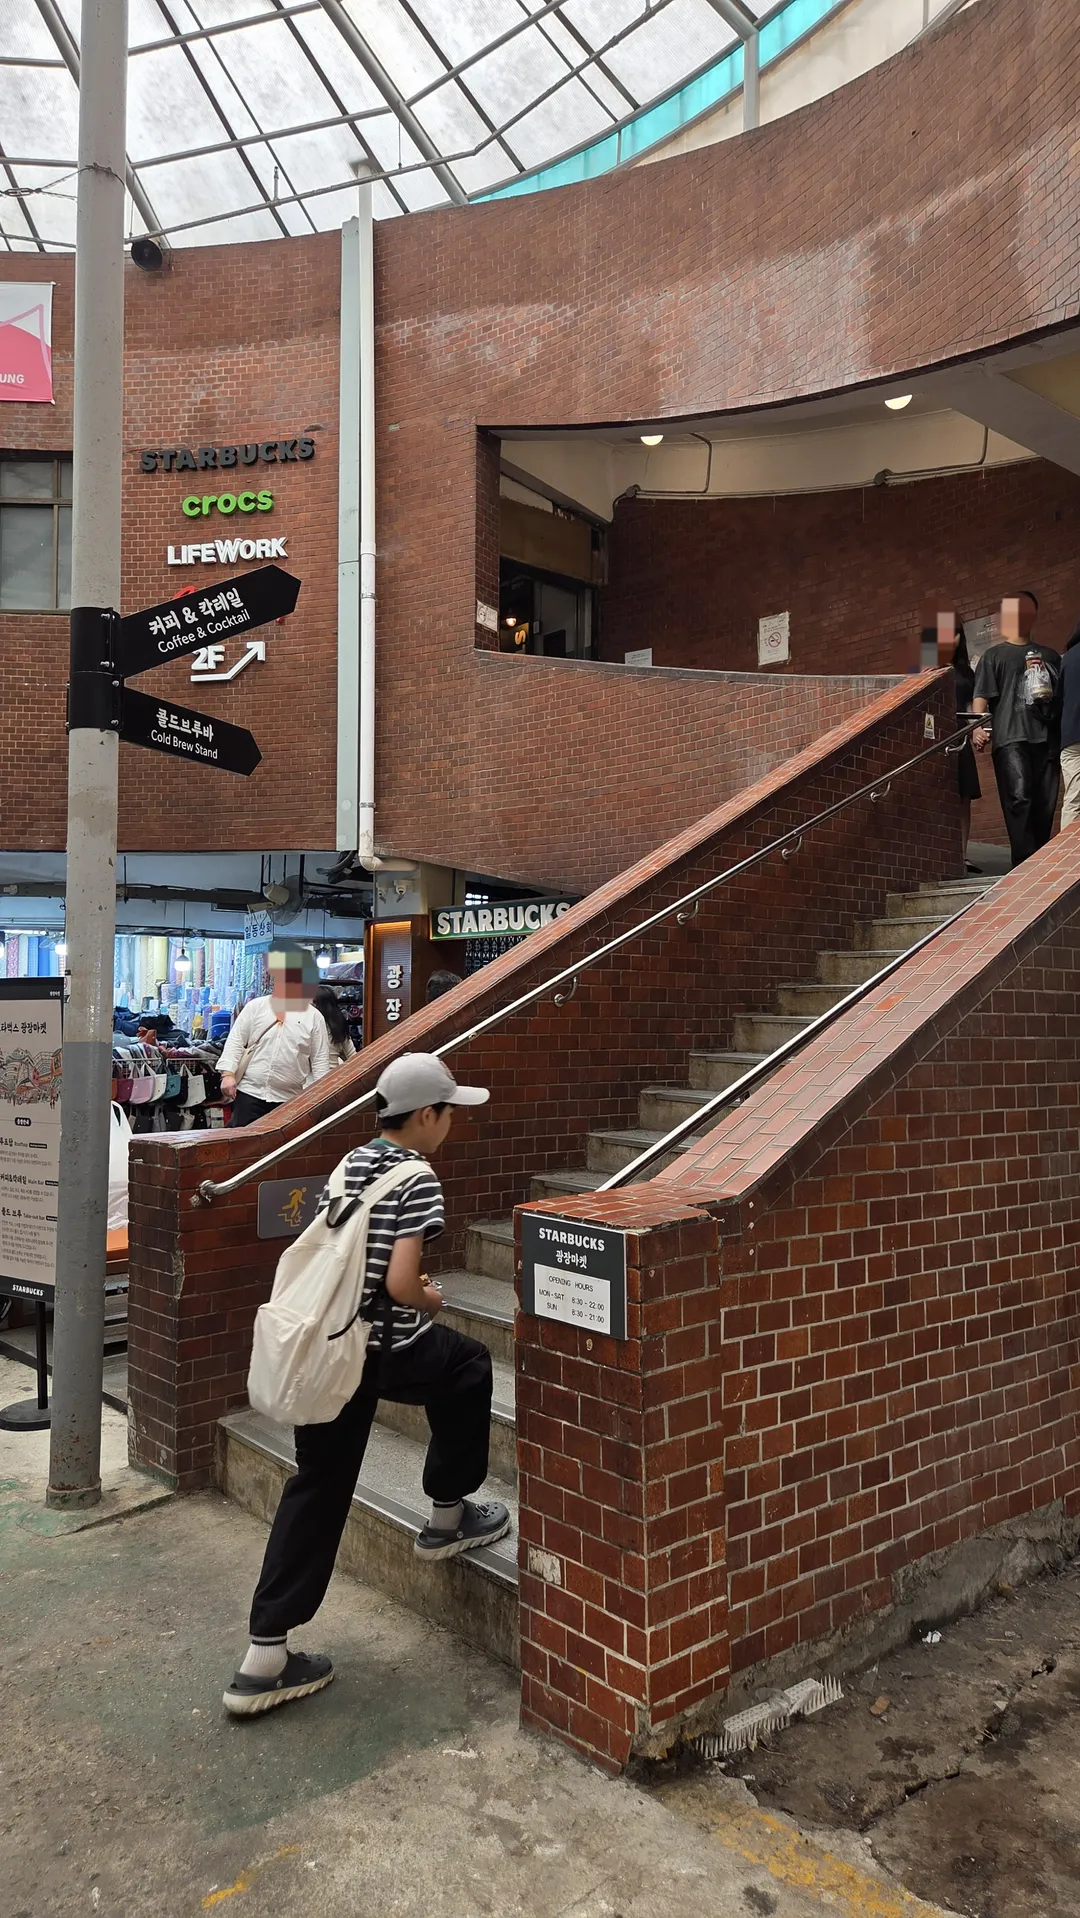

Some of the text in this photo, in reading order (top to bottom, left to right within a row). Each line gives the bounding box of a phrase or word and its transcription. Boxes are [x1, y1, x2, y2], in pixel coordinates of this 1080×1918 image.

[140, 437, 316, 472] STARBUCKS
[182, 490, 274, 517] crocs
[167, 537, 289, 566] LIFEWORK
[148, 587, 244, 635] 커피 & 칵테일
[157, 608, 250, 653] Coffee & Cocktail
[191, 645, 226, 670] 2F
[156, 708, 214, 742] 콜드브루바
[150, 729, 218, 759] Cold Brew Stand
[386, 965, 402, 1021] 광장
[21, 1021, 47, 1034] 광장마켓
[538, 1227, 605, 1252] STARBUCKS
[555, 1249, 587, 1269] 광장마켓
[12, 1284, 44, 1297] STARBUCKS
[548, 1275, 593, 1292] OPENING HOURS
[546, 1302, 557, 1311] SUN
[588, 1313, 604, 1323] 21:00
[588, 1300, 604, 1311] 22:00
